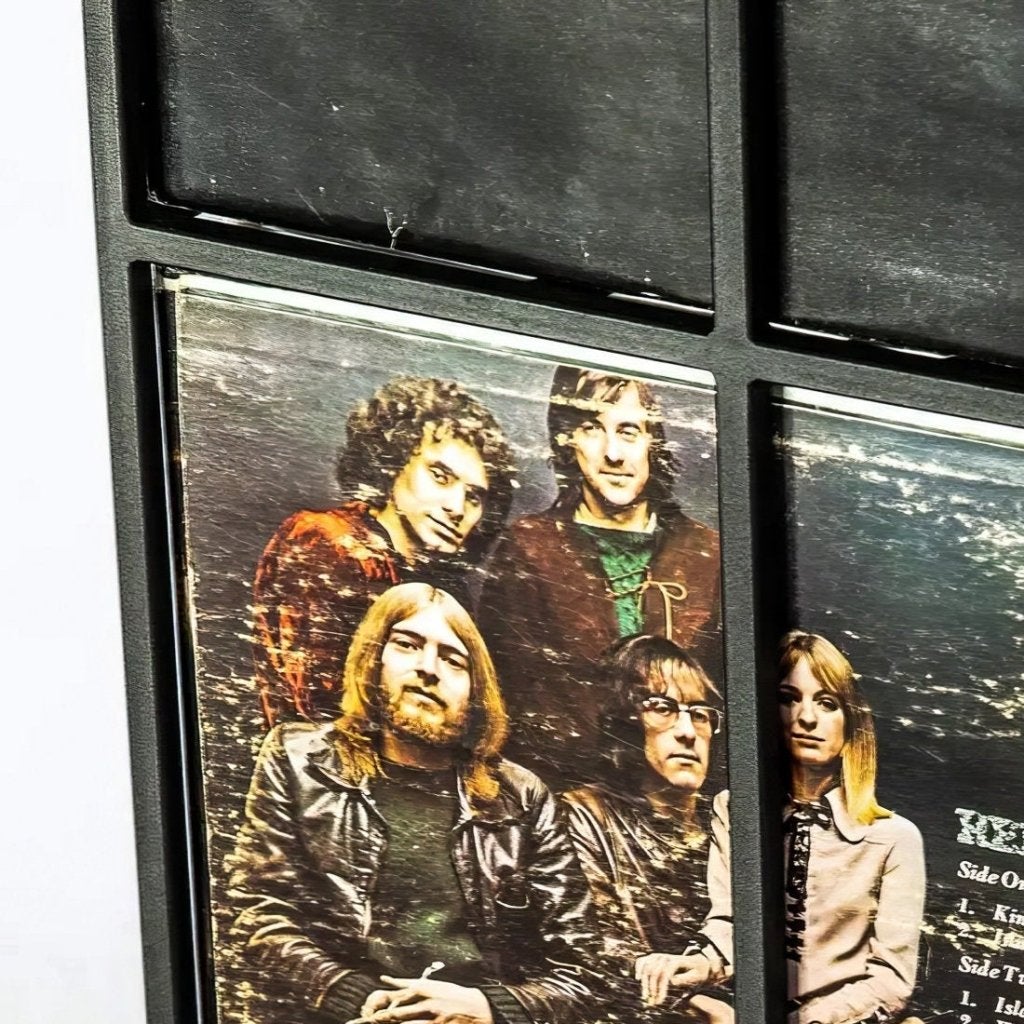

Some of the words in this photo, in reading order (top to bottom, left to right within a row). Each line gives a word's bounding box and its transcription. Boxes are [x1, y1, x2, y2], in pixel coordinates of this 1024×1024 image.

[957, 861, 1000, 885] Side
[959, 898, 975, 914] 1.
[958, 955, 1000, 979] Side
[959, 990, 977, 1006] 1.
